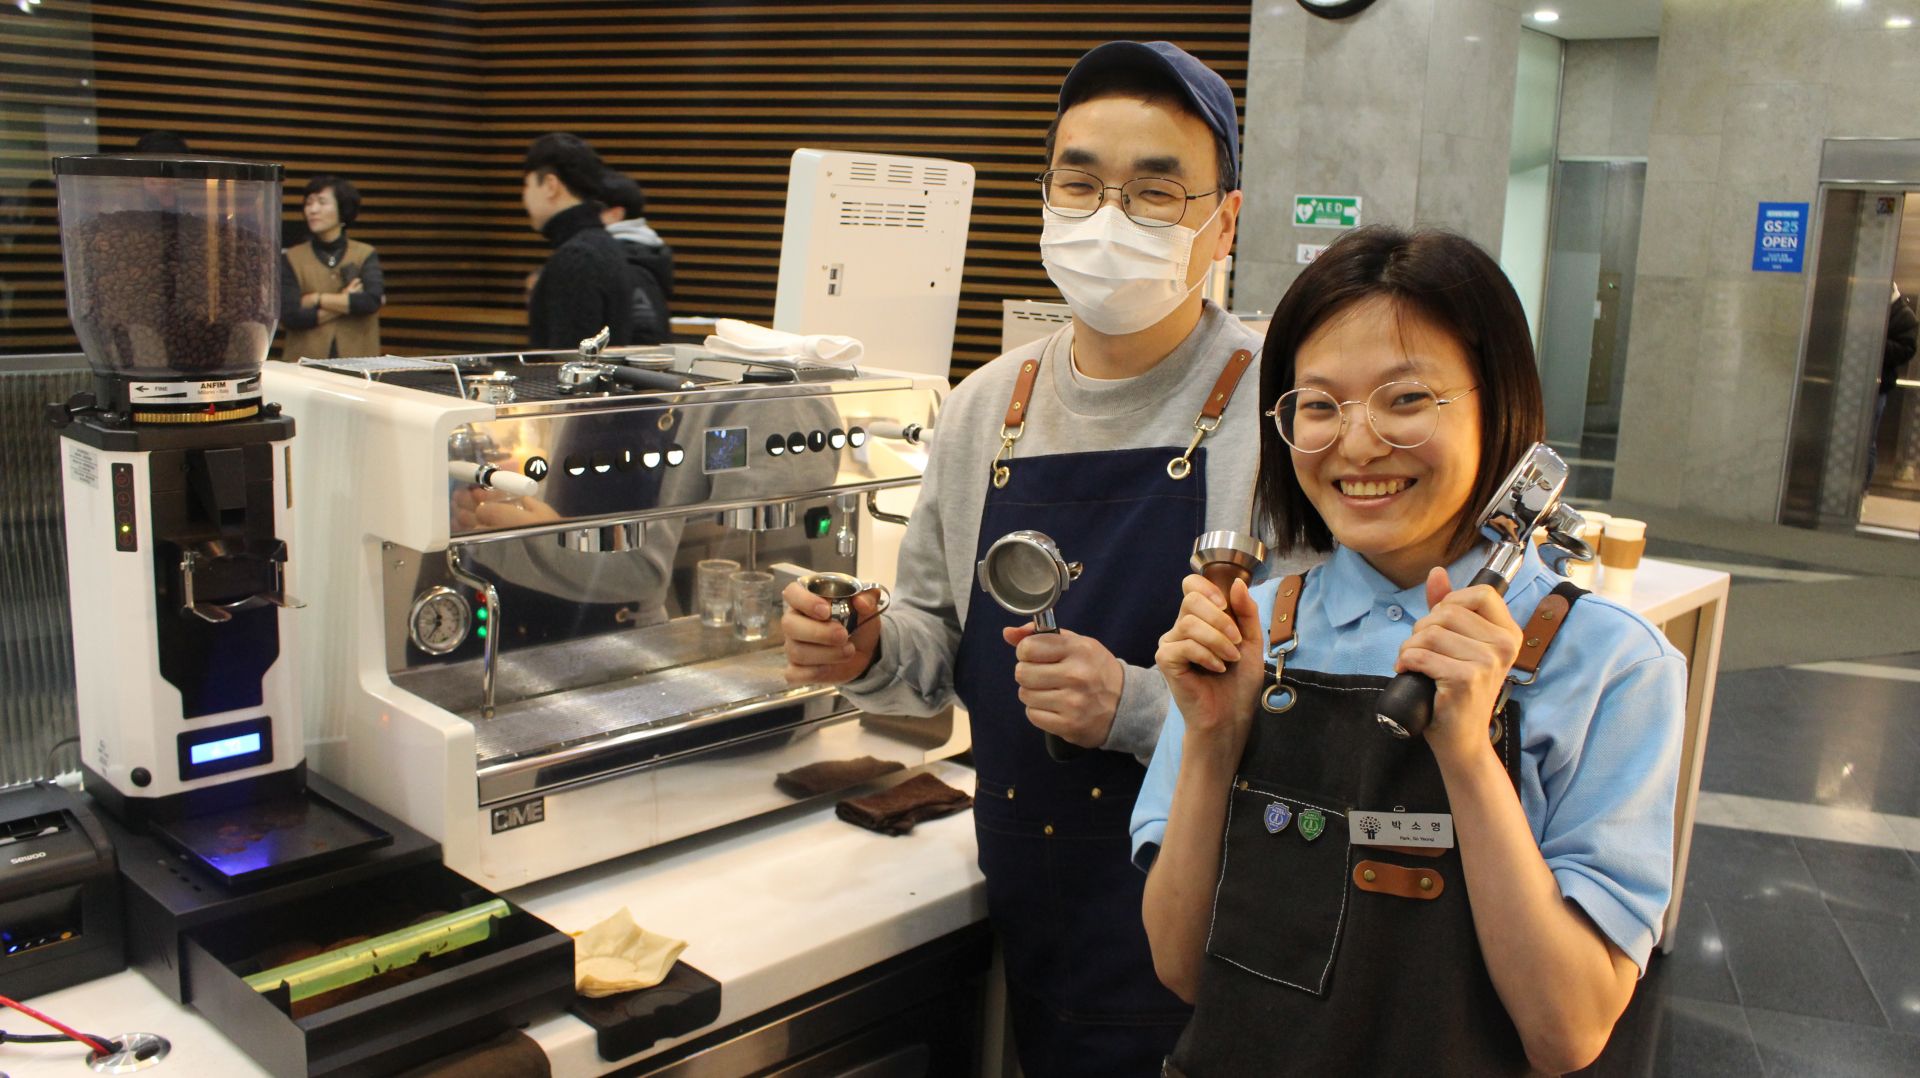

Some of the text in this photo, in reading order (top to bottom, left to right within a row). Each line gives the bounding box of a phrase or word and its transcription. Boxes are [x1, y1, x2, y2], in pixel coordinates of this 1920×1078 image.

[1316, 202, 1343, 213] AED
[1764, 220, 1799, 233] GS25
[1762, 236, 1798, 249] OPEN
[200, 381, 226, 389] ANFIM
[493, 800, 543, 830] CIME
